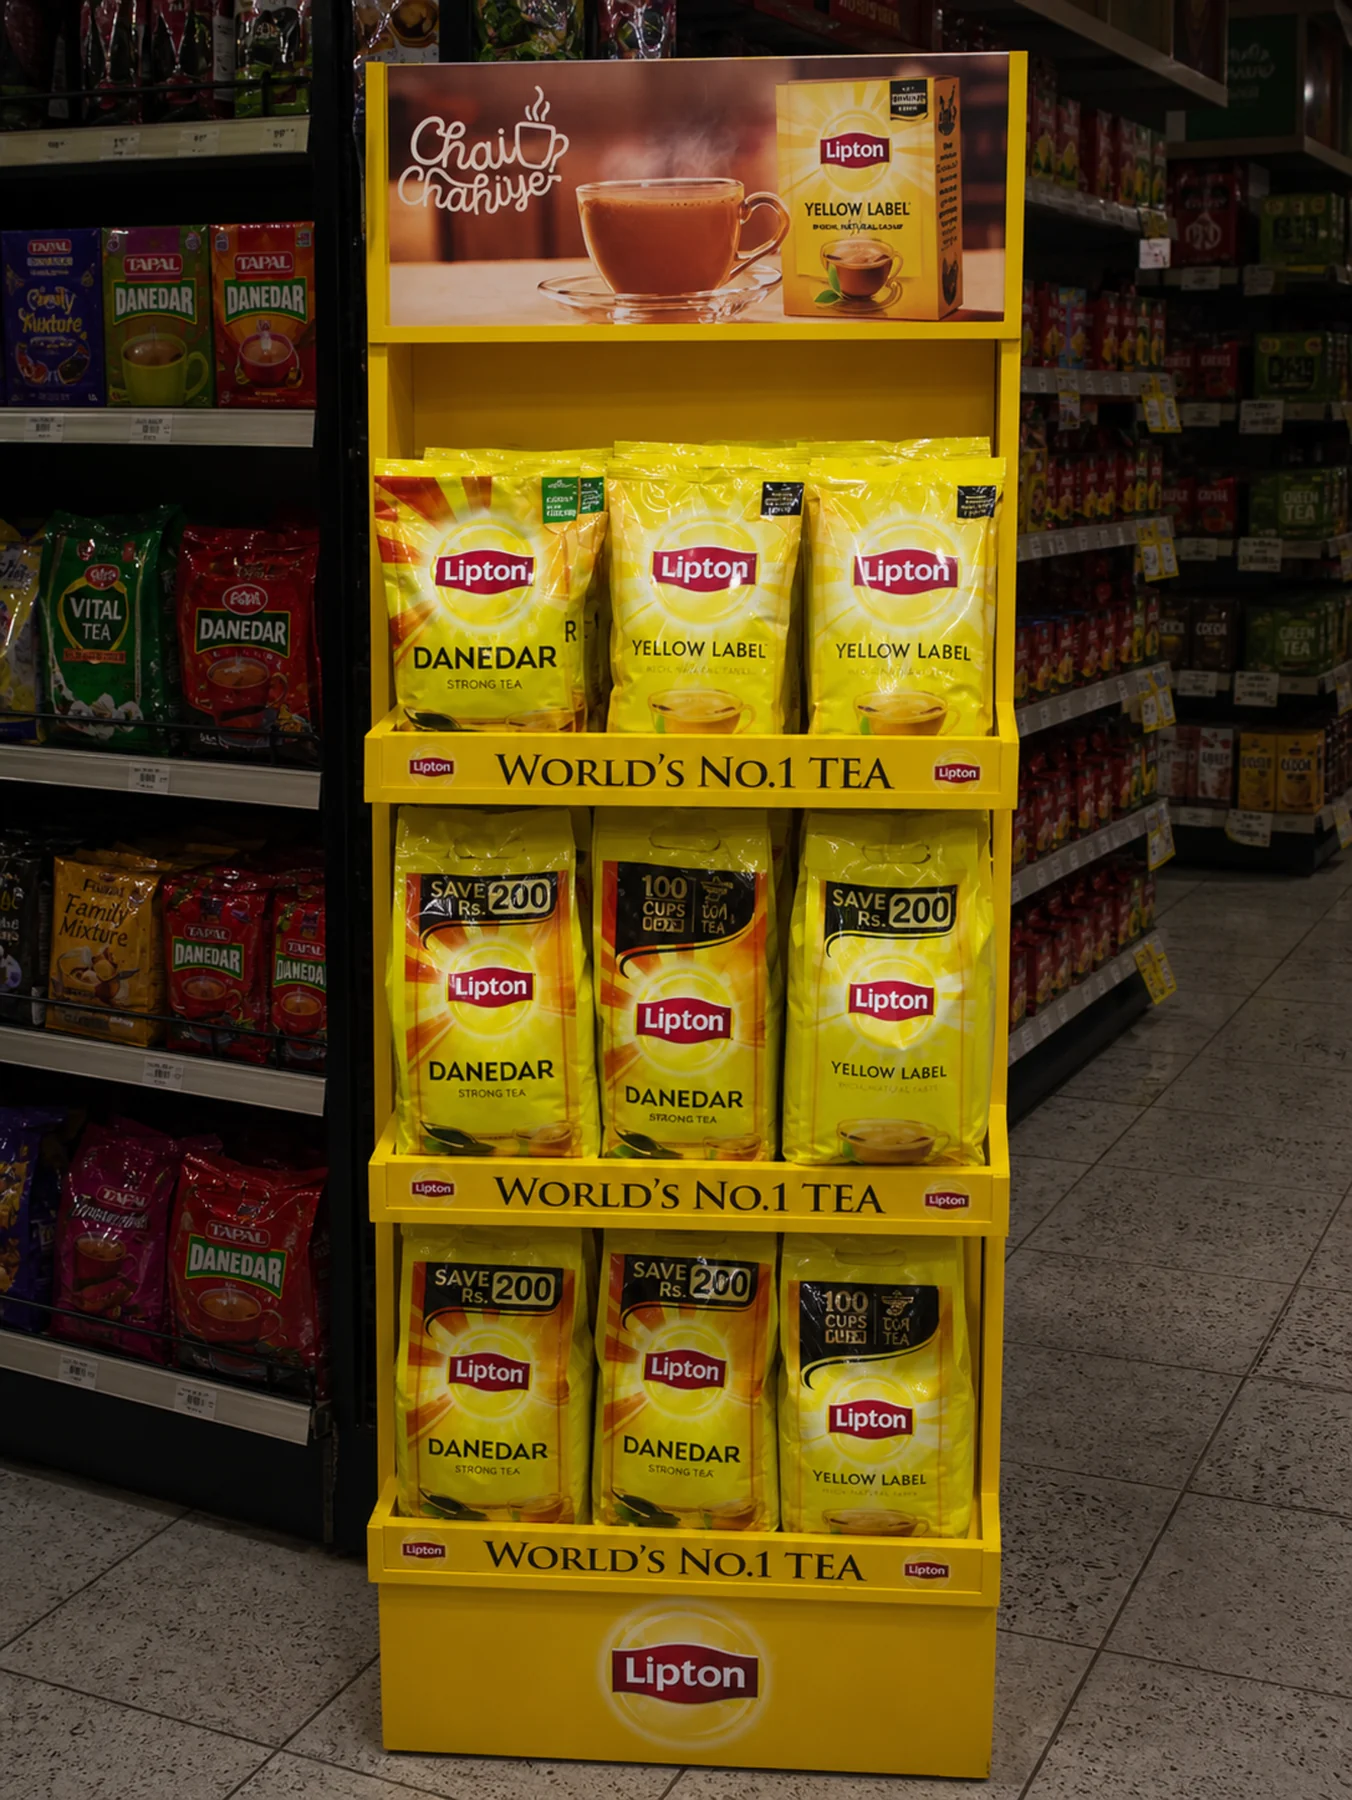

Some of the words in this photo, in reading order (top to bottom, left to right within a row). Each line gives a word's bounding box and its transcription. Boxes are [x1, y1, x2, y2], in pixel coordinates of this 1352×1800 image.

[411, 116, 517, 171] Chai
[826, 141, 884, 162] Lipton
[805, 202, 863, 217] YELLOW
[867, 202, 910, 217] LABEL
[126, 256, 180, 272] TAPAL
[235, 254, 291, 270] TAPAL
[115, 286, 194, 316] DANEDAR
[226, 284, 305, 315] DANEDAR
[1285, 504, 1317, 522] TEA
[445, 559, 527, 586] Lipton
[662, 556, 748, 584] Lipton
[863, 560, 949, 587] Lipton
[70, 596, 122, 621] VITAL
[81, 622, 112, 641] TEA
[199, 617, 286, 646] DANEDAR
[414, 645, 557, 671] DANEDAR
[632, 640, 706, 657] YELLOW
[712, 641, 766, 659] LABEL
[836, 643, 910, 659] YELLOW
[917, 643, 971, 661] LABEL
[1282, 640, 1311, 656] TEA
[447, 679, 497, 690] STRONG
[500, 679, 522, 690] TEA
[414, 760, 450, 774] Lipton
[494, 753, 685, 787] WORLD'S
[808, 757, 895, 789] TEA
[938, 766, 977, 780] Lipton
[430, 881, 485, 899] SAVE
[641, 875, 688, 899] 100
[65, 893, 129, 928] Family
[458, 900, 486, 917] Rs.
[492, 882, 548, 911] 200
[642, 901, 686, 918] CUPS
[832, 888, 886, 911] SAVE
[857, 910, 886, 928] Rs.
[893, 895, 949, 924] 200
[58, 916, 128, 947] Mixture
[701, 919, 726, 935] TEA
[175, 945, 241, 973] DANEDAR
[456, 977, 527, 998] Lipton
[855, 988, 928, 1013] Lipton
[644, 1006, 723, 1034] Lipton
[429, 1059, 554, 1082] DANEDAR
[831, 1060, 896, 1079] YELLOW
[901, 1065, 947, 1080] LABEL
[458, 1087, 503, 1098] STRONG
[505, 1088, 526, 1098] TEA
[625, 1085, 743, 1108] DANEDAR
[649, 1113, 694, 1123] STRONG
[696, 1114, 717, 1124] TEA
[415, 1183, 451, 1196] Lipton
[493, 1176, 679, 1210] WORLD'S
[801, 1183, 886, 1214] TEA
[928, 1194, 966, 1208] Lipton
[210, 1223, 267, 1245] TAPAL
[188, 1243, 284, 1288] DANEDAR
[633, 1262, 687, 1281] SAVE
[434, 1269, 489, 1288] SAVE
[461, 1287, 489, 1304] Rs.
[496, 1275, 551, 1301] 200
[659, 1281, 687, 1299] Rs.
[693, 1268, 748, 1296] 200
[825, 1290, 869, 1313] 100
[825, 1314, 868, 1329] CUPS
[882, 1331, 910, 1346] TEA
[456, 1360, 523, 1384] Lipton
[651, 1357, 719, 1381] Lipton
[835, 1409, 906, 1432] Lipton
[428, 1438, 548, 1460] DANEDAR
[623, 1435, 741, 1463] DANEDAR
[455, 1465, 498, 1476] STRONG
[500, 1467, 520, 1476] TEA
[648, 1464, 690, 1477] STRONG
[692, 1468, 714, 1478] TEA
[812, 1469, 876, 1486] YELLOW
[881, 1473, 927, 1486] LABEL
[406, 1544, 442, 1557] Lipton
[483, 1540, 665, 1574] WORLD'S
[784, 1552, 867, 1582] TEA
[908, 1564, 946, 1577] Lipton
[625, 1656, 745, 1692] Lipton
